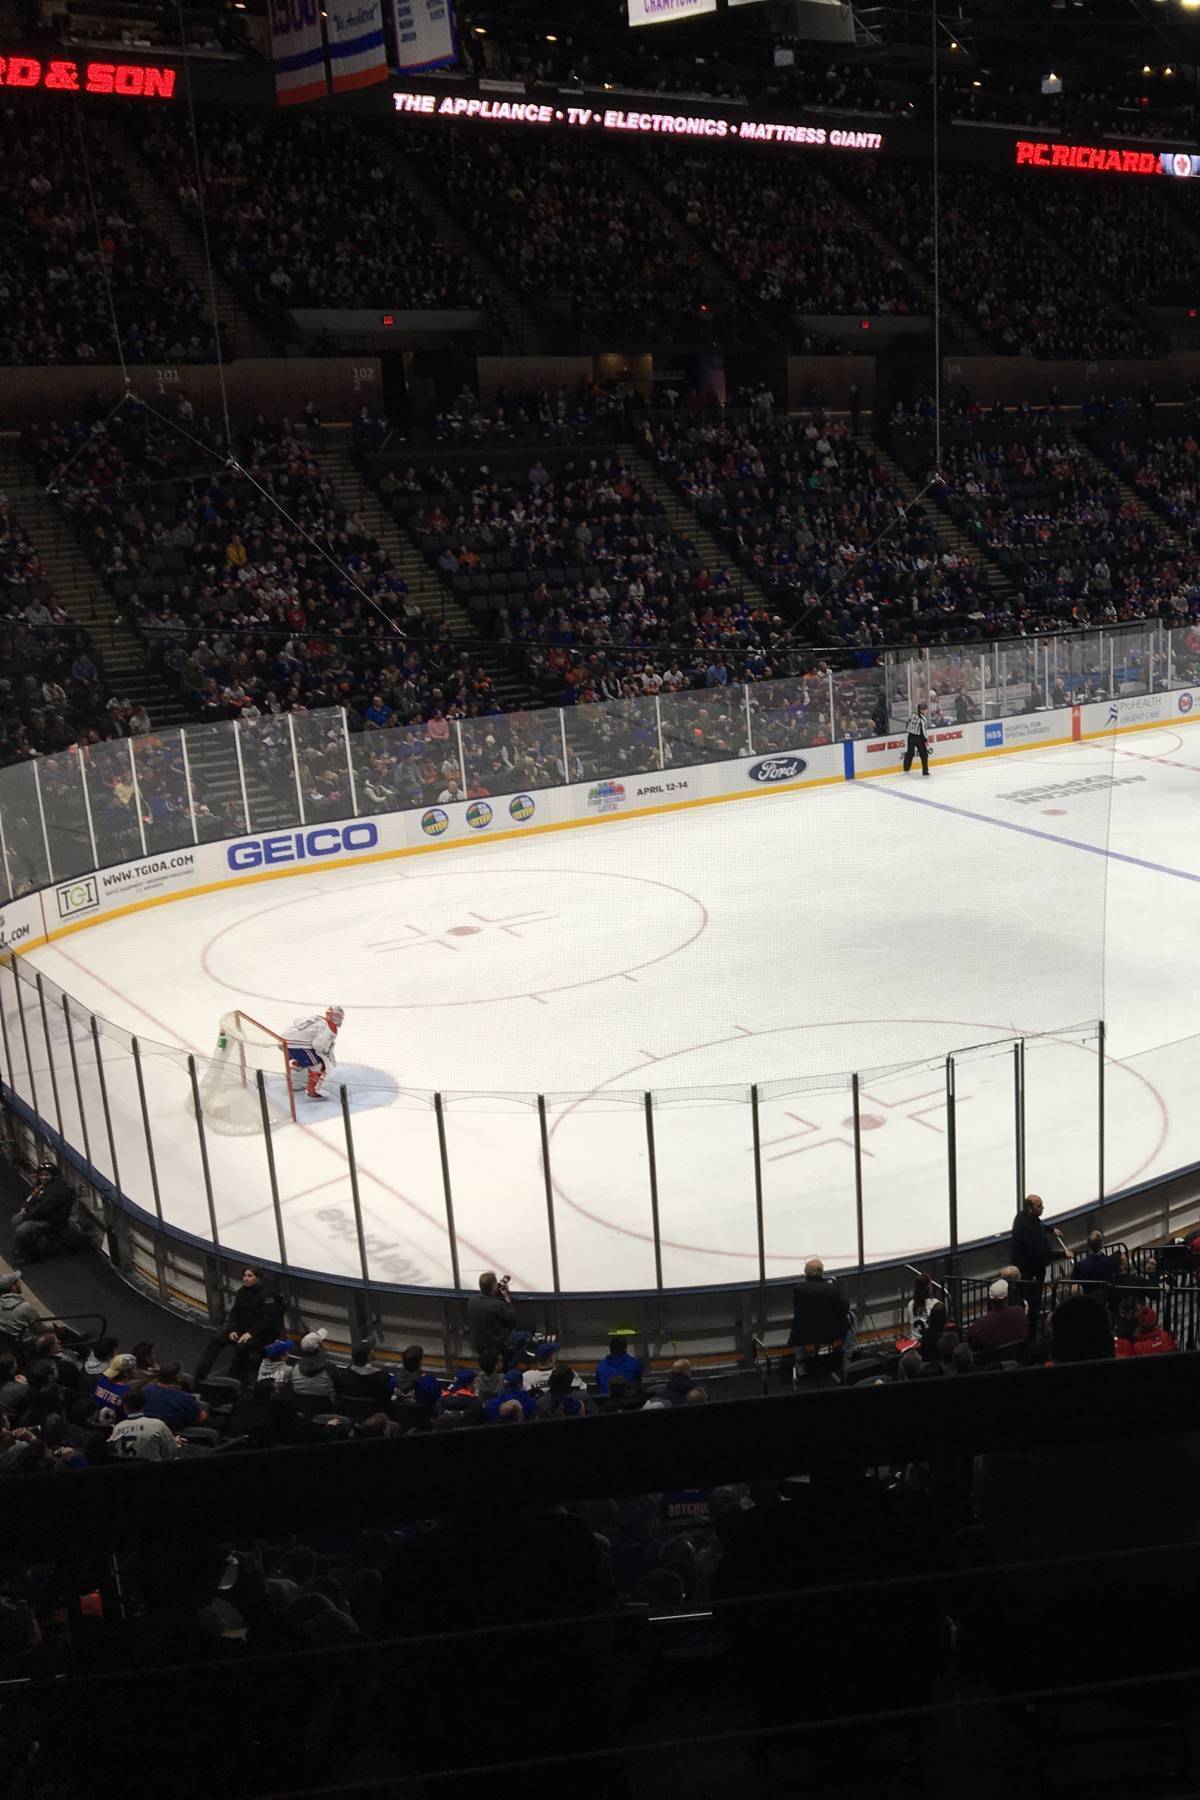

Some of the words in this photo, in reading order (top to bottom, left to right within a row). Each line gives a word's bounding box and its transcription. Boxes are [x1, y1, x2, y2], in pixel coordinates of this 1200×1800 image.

[0, 57, 41, 87] D
[45, 61, 79, 90] &
[86, 63, 176, 98] SON
[393, 92, 436, 113] THE
[438, 96, 553, 122] APPLIANCE
[567, 107, 592, 125] TV
[604, 110, 727, 136] ELECTRONICS
[739, 121, 826, 145] MATTRESS
[829, 129, 882, 149] GIANT!
[1051, 144, 1156, 174] RICHARD
[986, 730, 1002, 740] HSS
[758, 757, 798, 781] Ford
[636, 783, 664, 797] APRIL
[666, 780, 688, 792] 12-14
[227, 822, 378, 871] GEICO
[102, 854, 195, 887] WWW.TGIOA.COM
